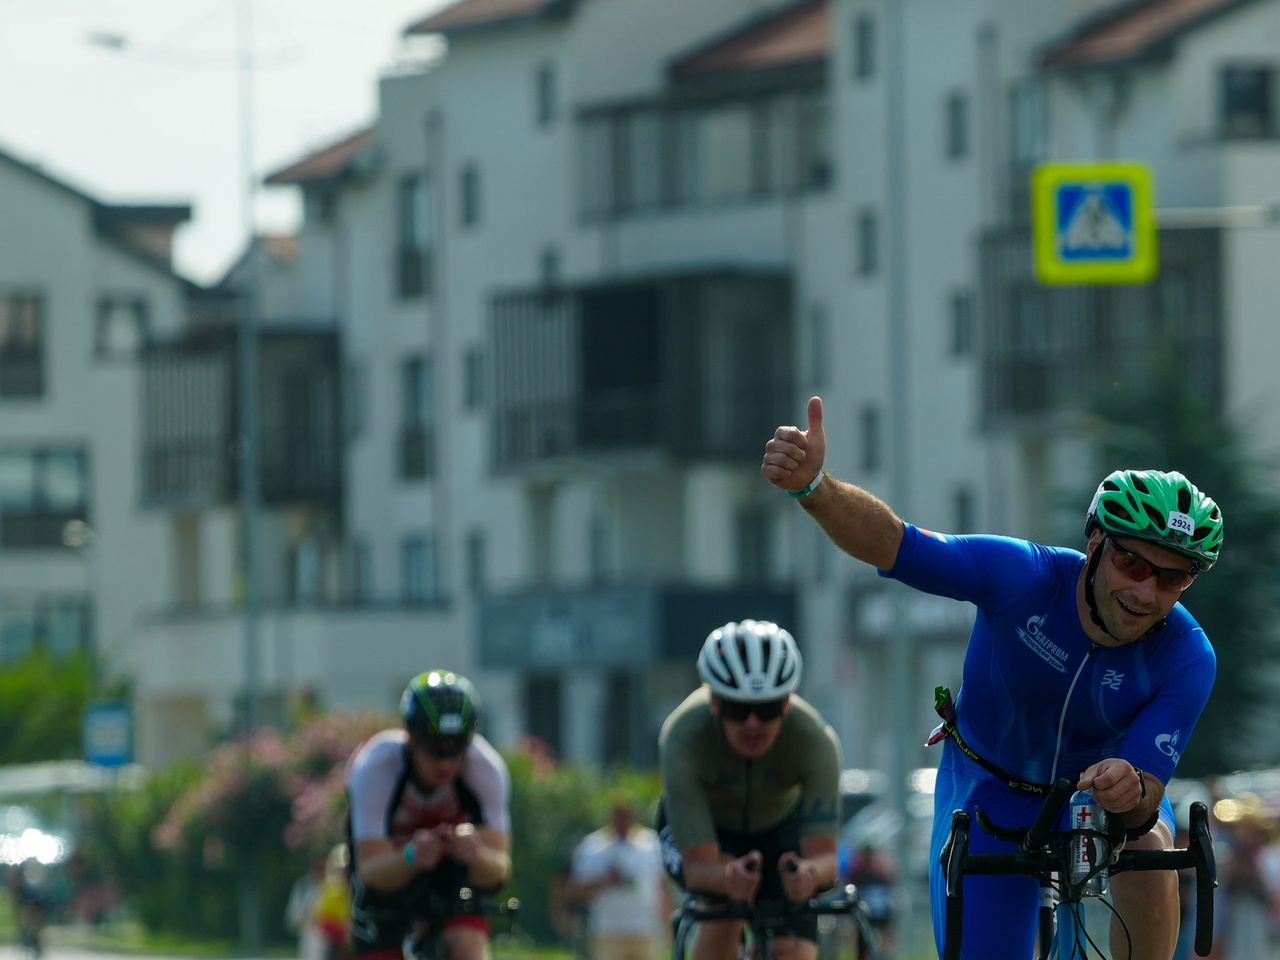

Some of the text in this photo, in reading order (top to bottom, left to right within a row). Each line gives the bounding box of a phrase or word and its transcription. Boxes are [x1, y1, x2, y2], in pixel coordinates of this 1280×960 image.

[1171, 518, 1191, 531] 2924
[1022, 633, 1051, 659] TRIATHLON
[1035, 630, 1069, 662] GAZPROM
